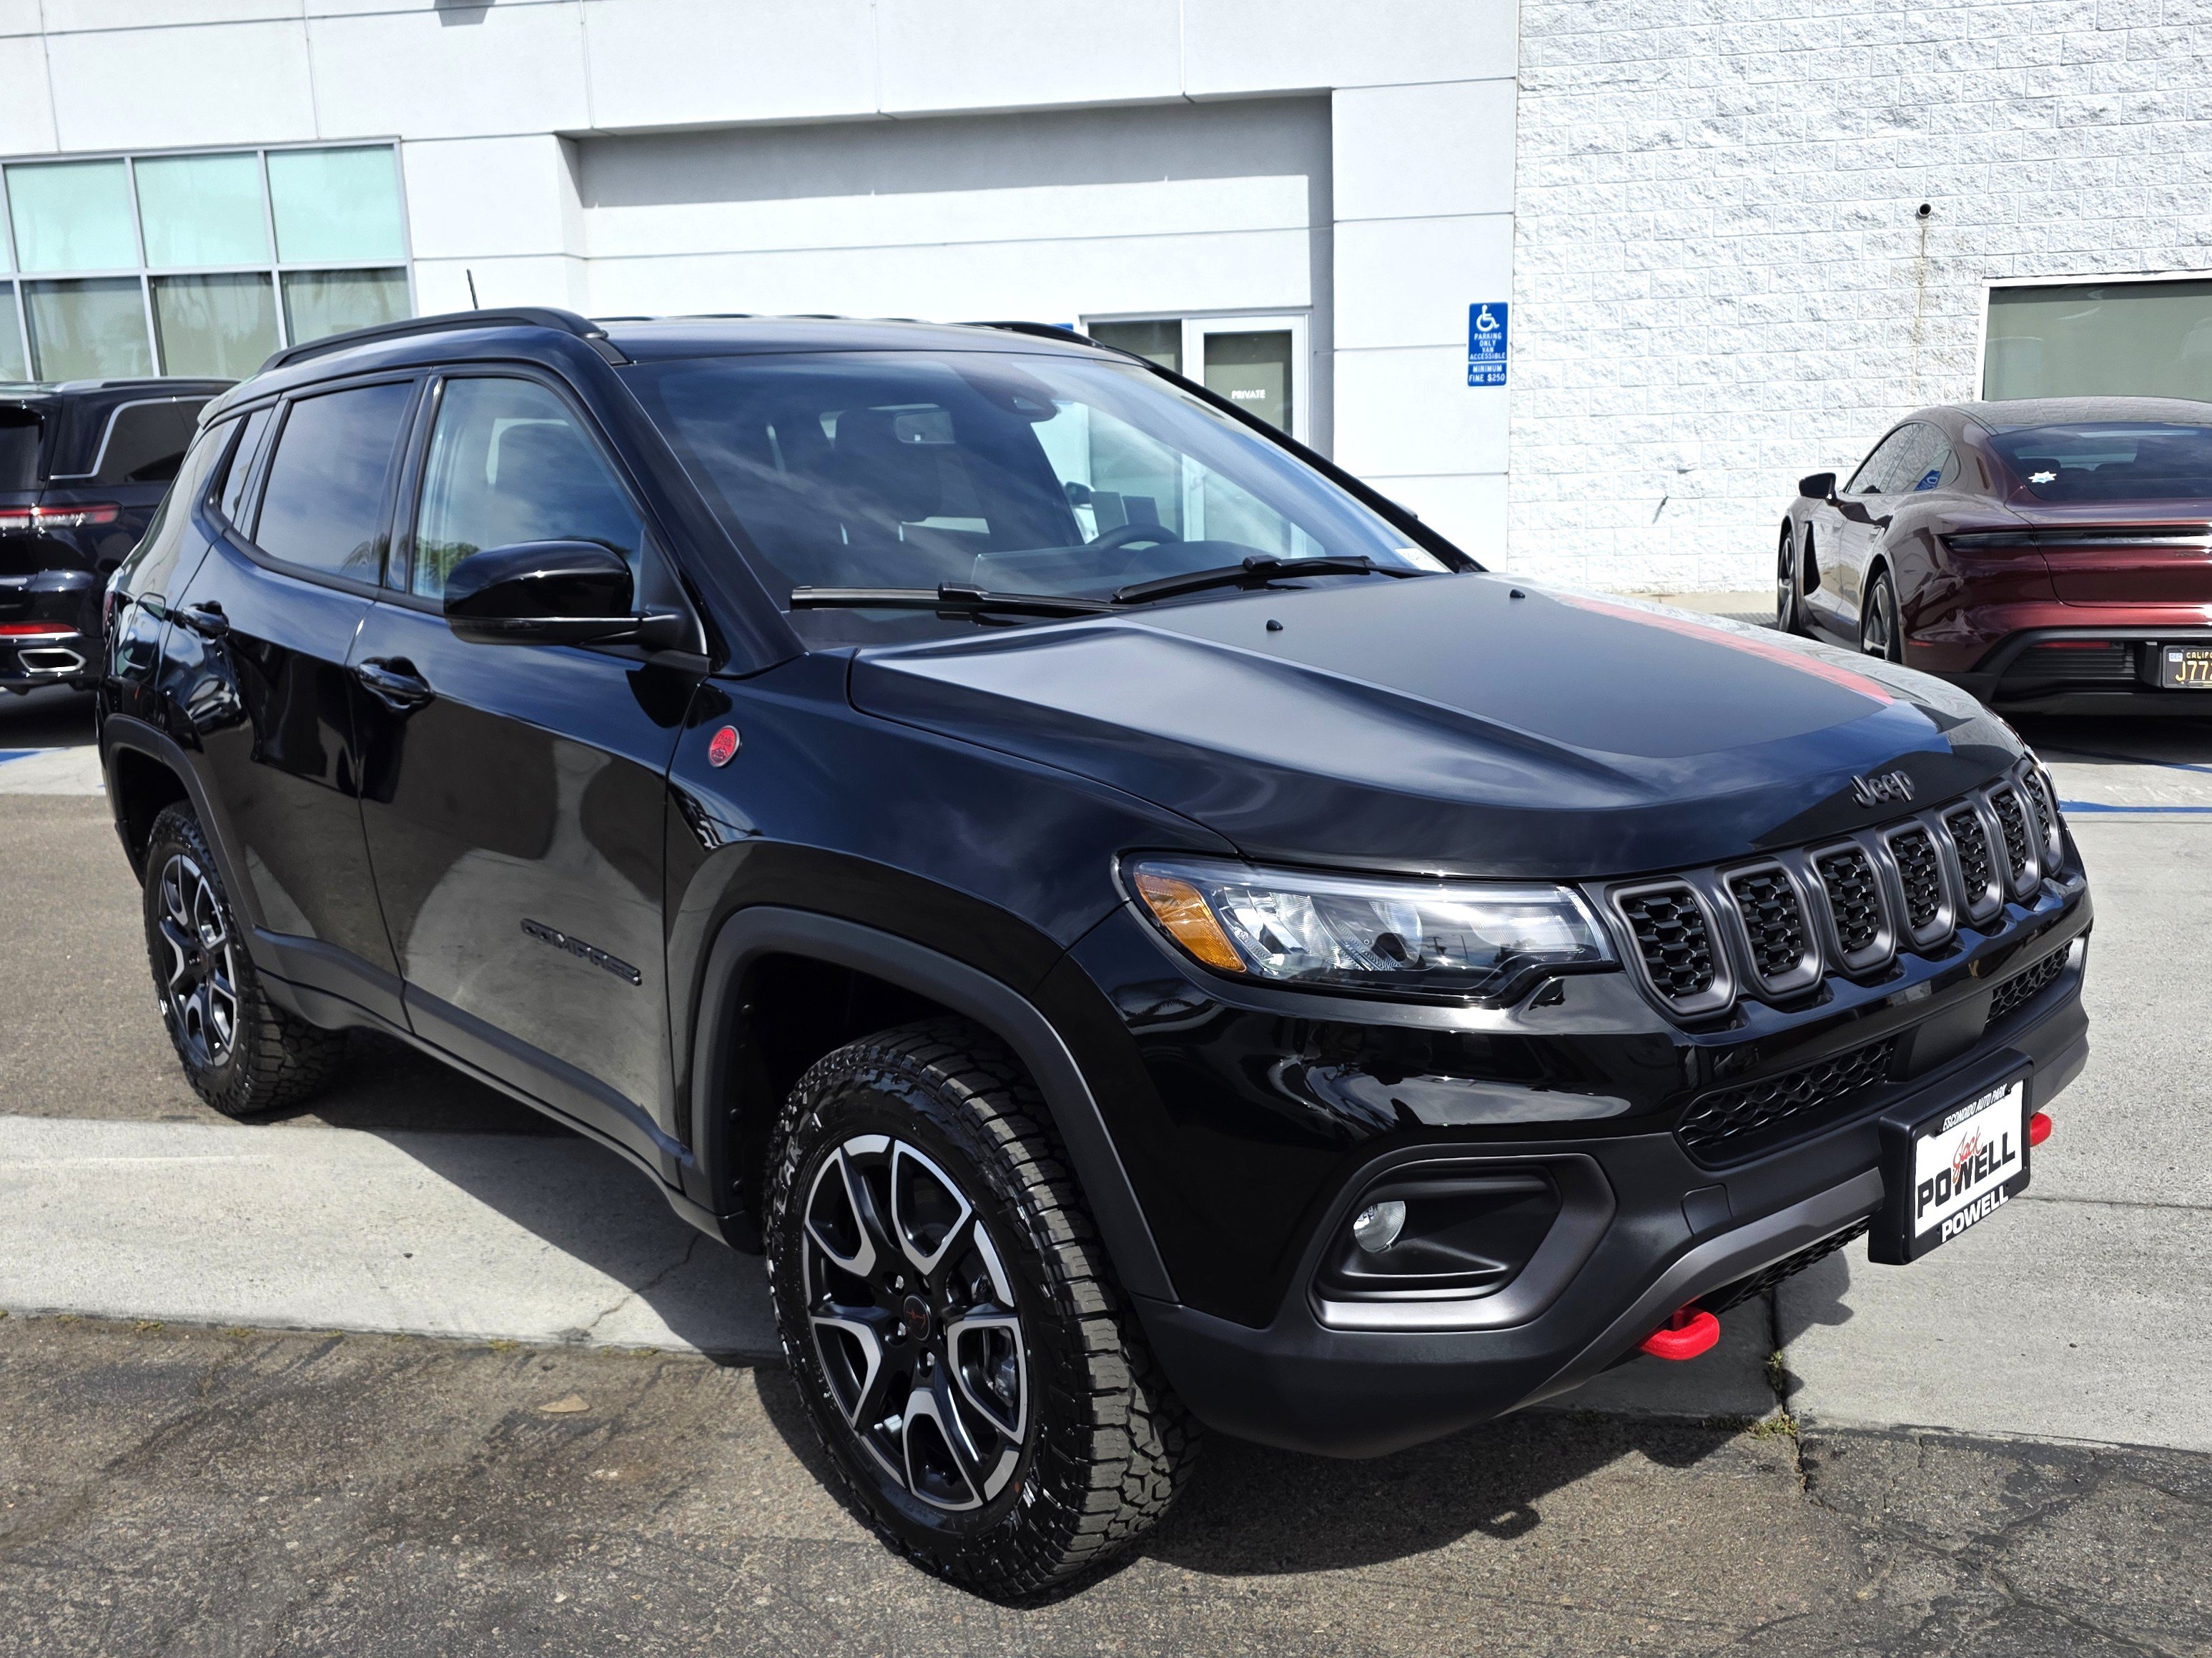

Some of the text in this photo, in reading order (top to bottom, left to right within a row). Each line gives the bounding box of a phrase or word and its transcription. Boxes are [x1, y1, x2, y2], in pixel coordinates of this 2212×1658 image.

[1470, 352, 1505, 360] ACCESSIBLE
[1487, 373, 1505, 382] $250
[1231, 389, 1265, 399] PRIVATE
[1850, 770, 1915, 808] Jeep
[1942, 1083, 2007, 1132] ESCONDIDO AUTO PARK
[1917, 1132, 2015, 1219] POWELL
[1952, 1125, 1983, 1184] Jack
[1942, 1185, 2008, 1243] POWELL
